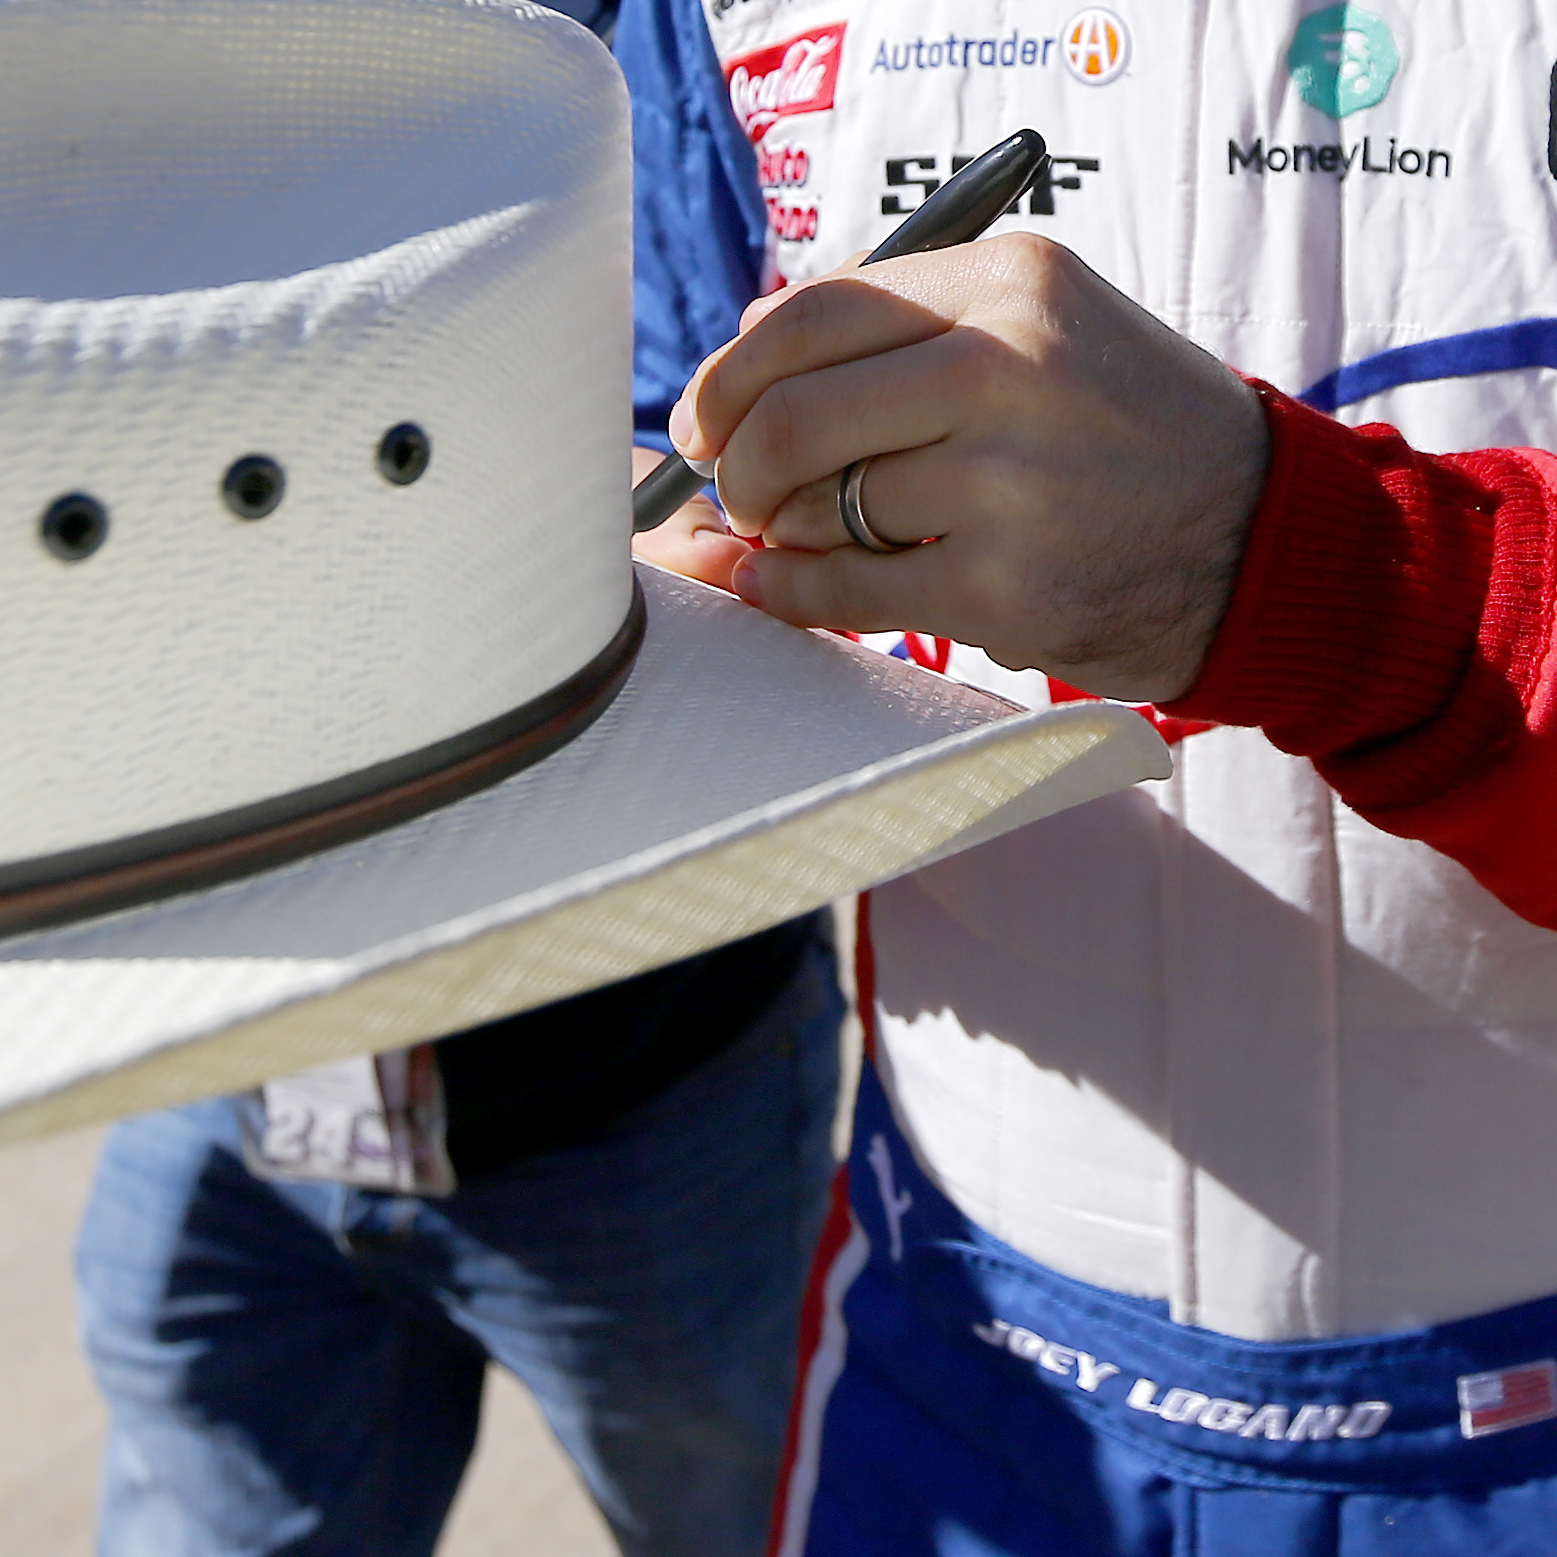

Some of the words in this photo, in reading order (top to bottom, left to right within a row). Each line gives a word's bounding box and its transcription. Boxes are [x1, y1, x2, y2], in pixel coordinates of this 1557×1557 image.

[871, 29, 1057, 75] Autotrader
[1228, 136, 1453, 182] MoneyLion
[881, 157, 1100, 215] SF
[973, 1317, 1121, 1393] JOEY
[1125, 1377, 1392, 1442] LOGANO
